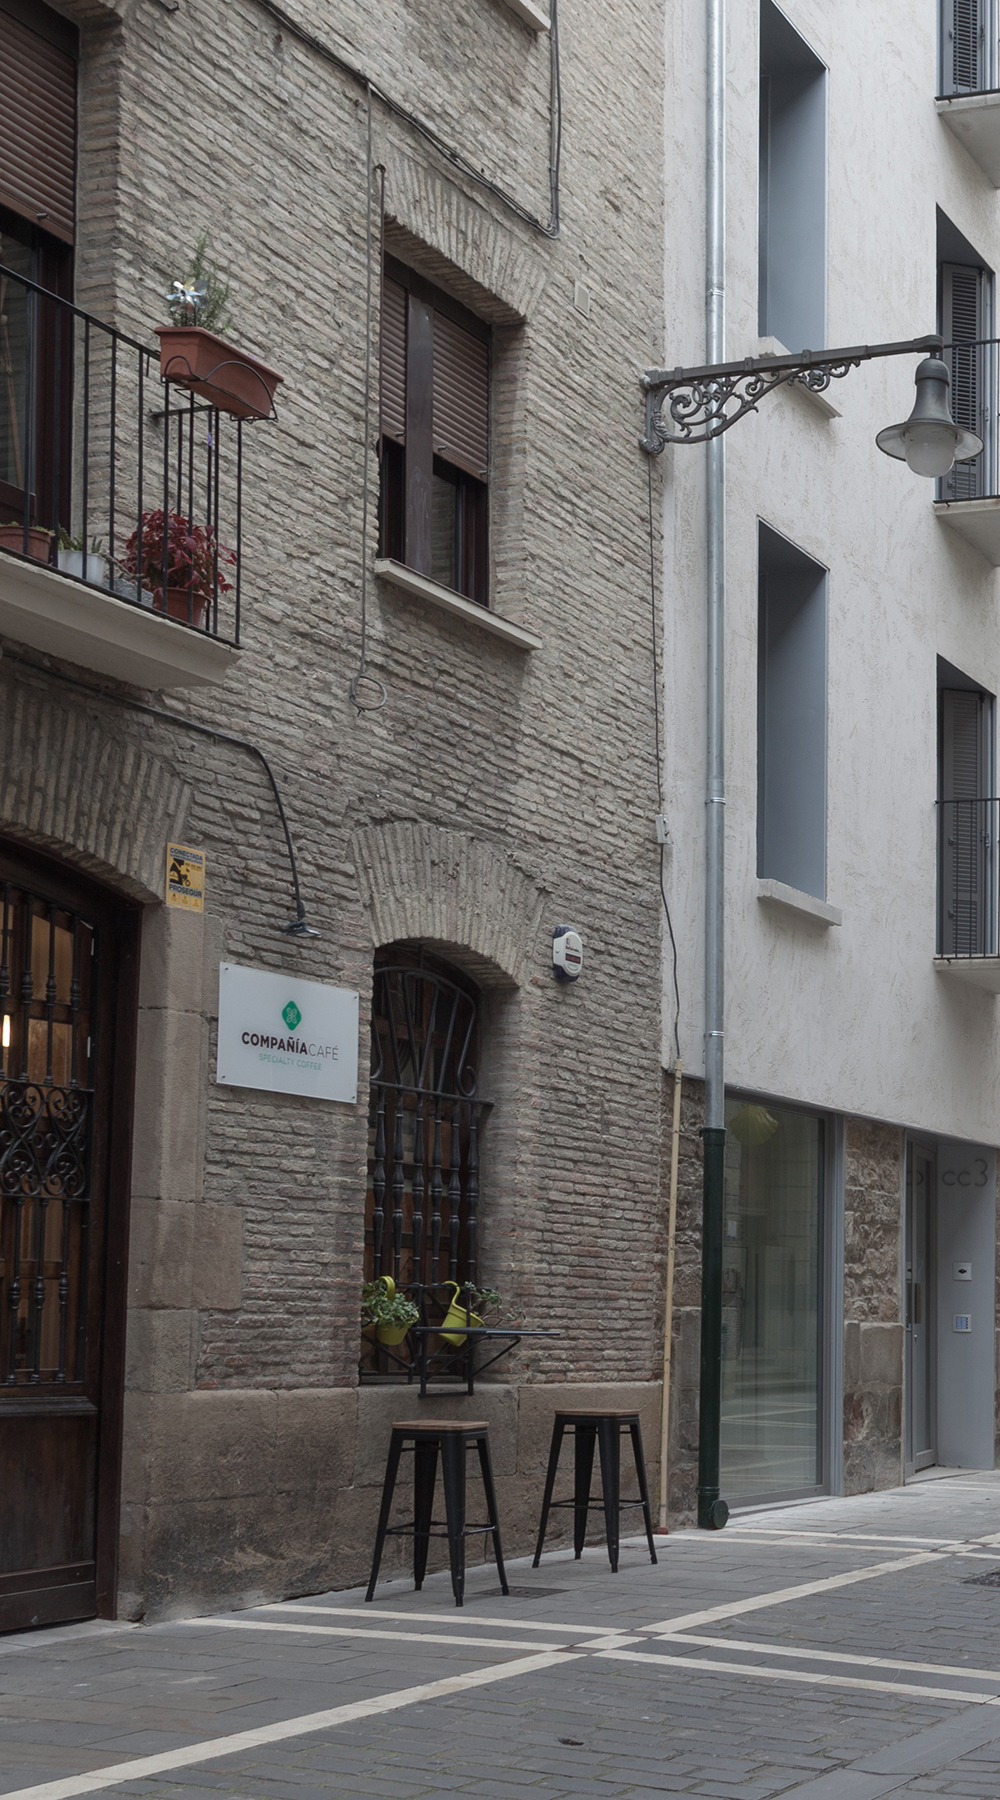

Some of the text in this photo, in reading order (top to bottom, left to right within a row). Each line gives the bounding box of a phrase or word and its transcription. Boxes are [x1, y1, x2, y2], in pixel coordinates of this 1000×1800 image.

[170, 847, 204, 861] CONECTADA
[169, 883, 203, 898] PROSEGUR
[258, 1053, 322, 1071] SPECIALTY COFFEE
[942, 1158, 988, 1187] cc3
